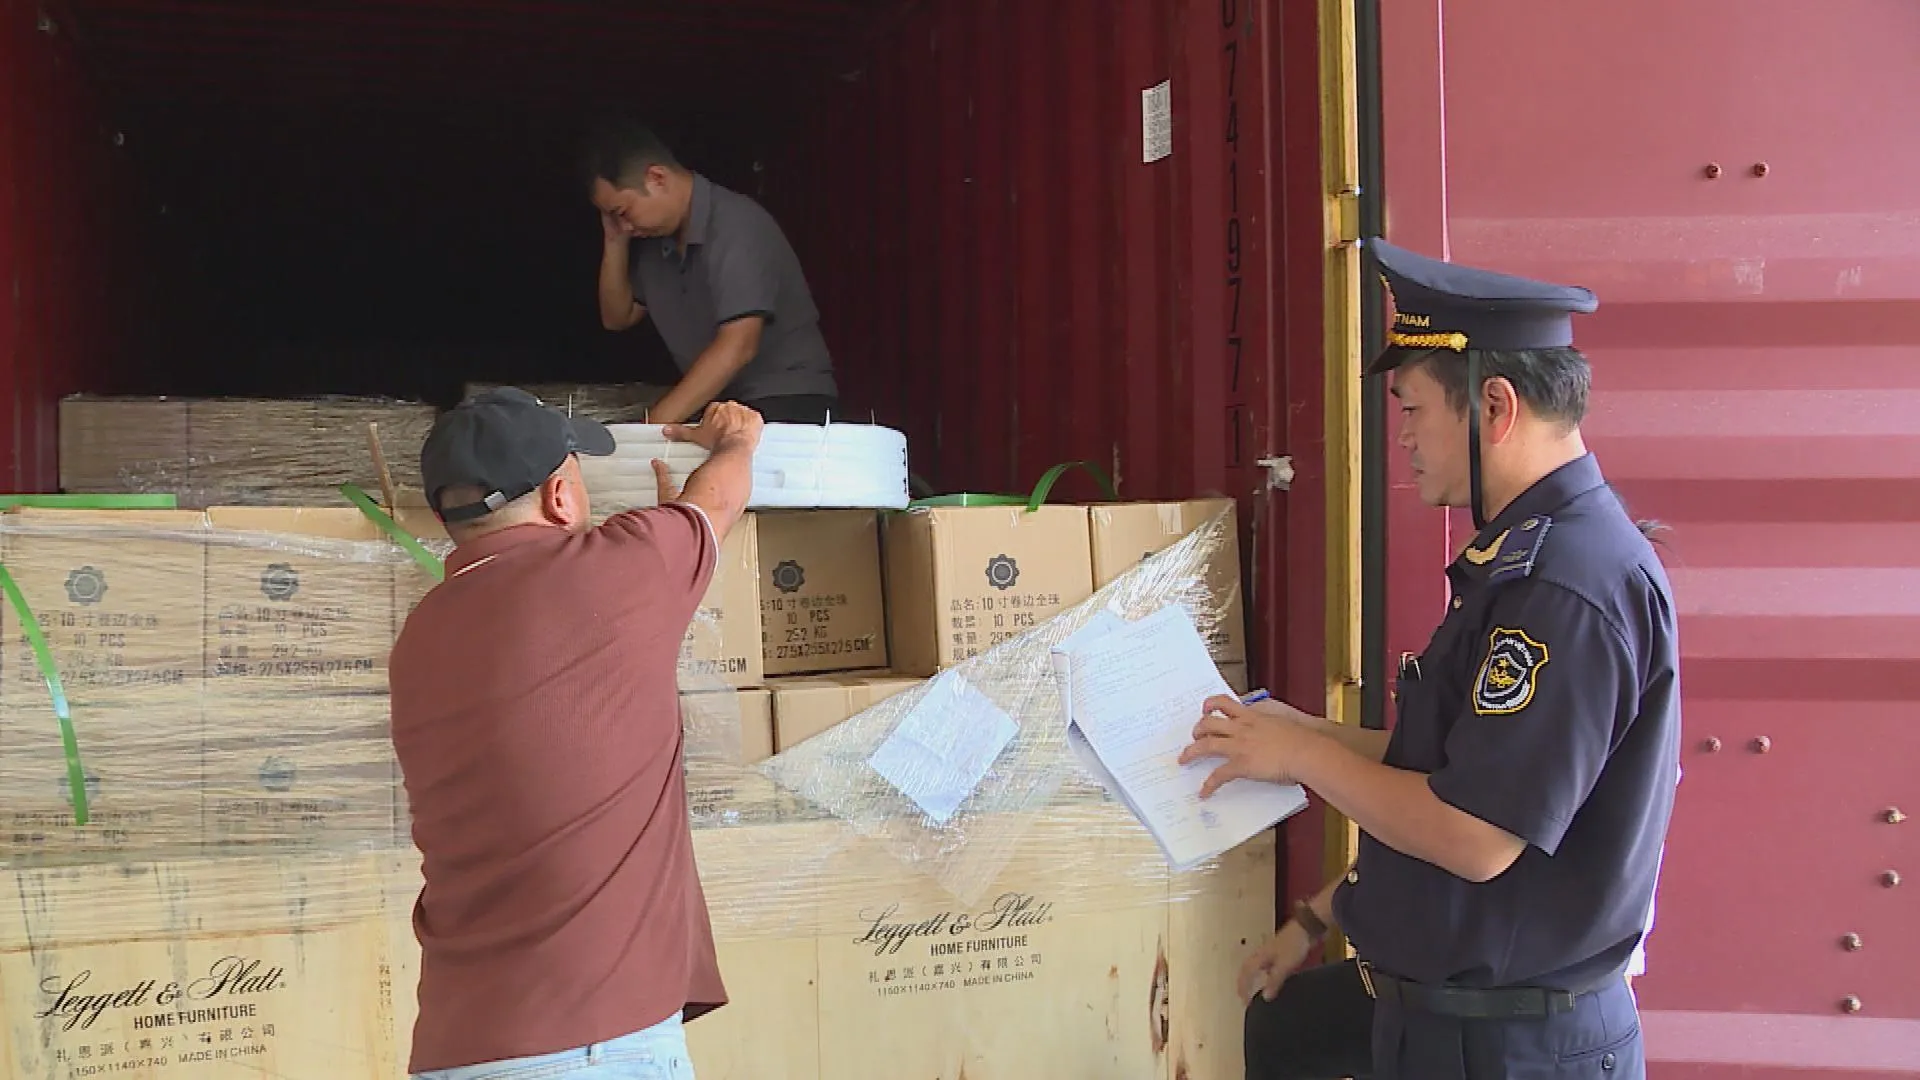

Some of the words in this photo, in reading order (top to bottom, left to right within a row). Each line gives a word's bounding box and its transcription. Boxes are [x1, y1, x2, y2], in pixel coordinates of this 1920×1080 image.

[810, 609, 830, 623] PCS
[993, 612, 1004, 627] 10
[1013, 612, 1035, 627] PCS
[853, 903, 950, 957] Leggett
[950, 914, 971, 936] &
[930, 940, 964, 957] HOME
[966, 934, 1029, 954] FURNITURE
[963, 975, 990, 988] MADE
[992, 973, 1004, 985] IN
[1005, 970, 1034, 983] CHINA
[33, 969, 156, 1032] Leggett
[156, 982, 184, 1007] &
[134, 1011, 176, 1031] HOME
[178, 1003, 257, 1025] FURNITURE
[178, 1049, 215, 1064] MADE
[215, 1047, 228, 1060] IN
[229, 1043, 268, 1058] CHINA
